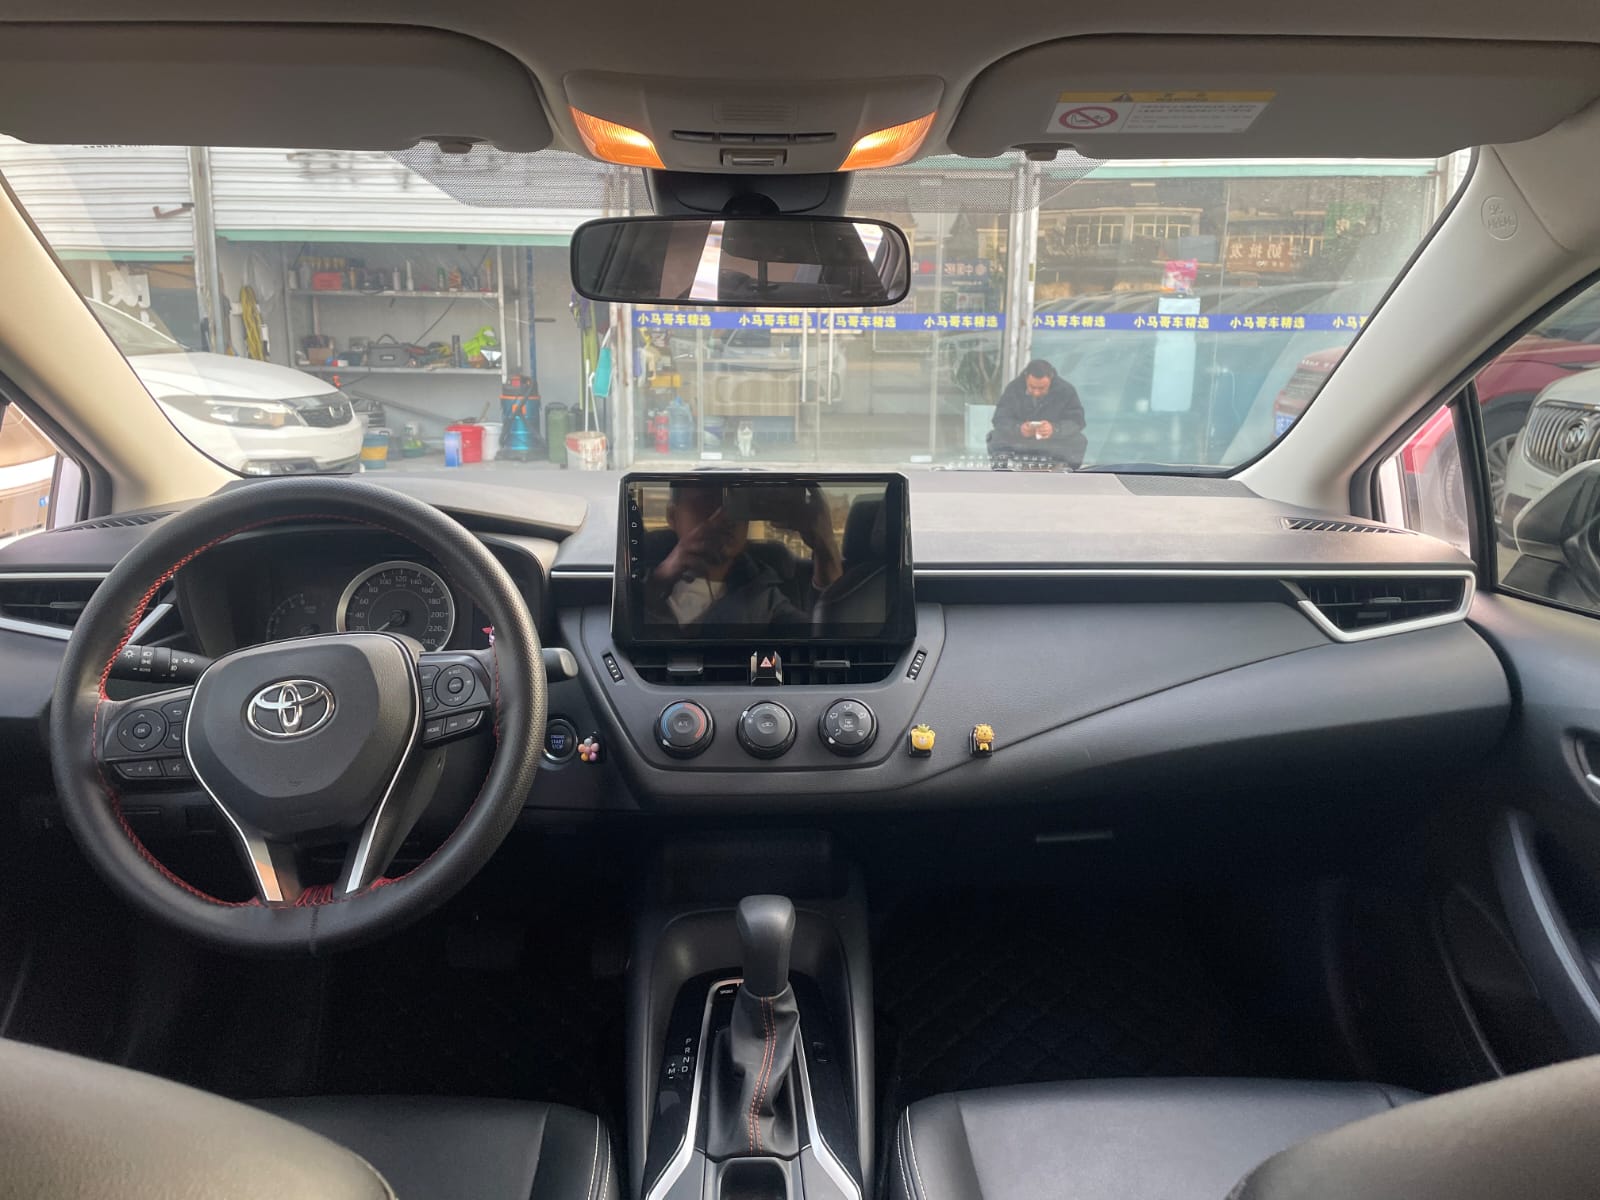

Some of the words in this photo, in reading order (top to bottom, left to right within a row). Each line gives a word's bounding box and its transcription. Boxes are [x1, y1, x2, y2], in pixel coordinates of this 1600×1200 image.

[637, 313, 712, 326] 小马哥车精选
[923, 316, 998, 328] 小马哥车精选
[1032, 315, 1106, 328] 小马哥车精选
[1134, 315, 1209, 329] 小马哥车精选
[1230, 316, 1305, 329] 小马哥车精选
[685, 1037, 692, 1045] P
[684, 1046, 691, 1054] R
[668, 1067, 676, 1075] M
[681, 1065, 689, 1073] D
